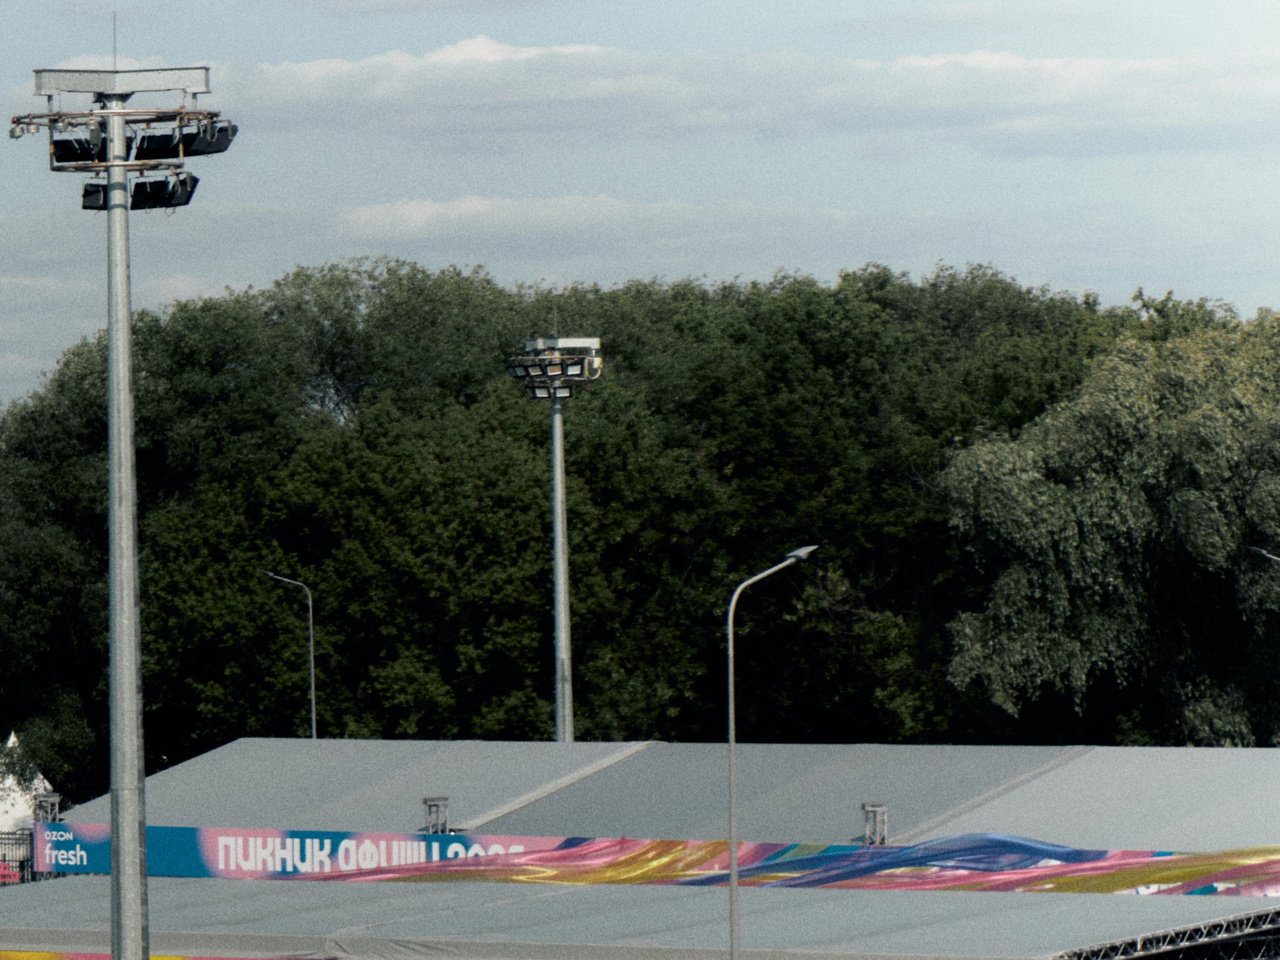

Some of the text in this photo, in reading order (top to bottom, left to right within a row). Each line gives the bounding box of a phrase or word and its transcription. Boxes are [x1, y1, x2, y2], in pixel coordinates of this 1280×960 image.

[44, 831, 74, 841] OZON
[44, 844, 88, 866] fresh
[217, 836, 332, 872] ПИКНИК
